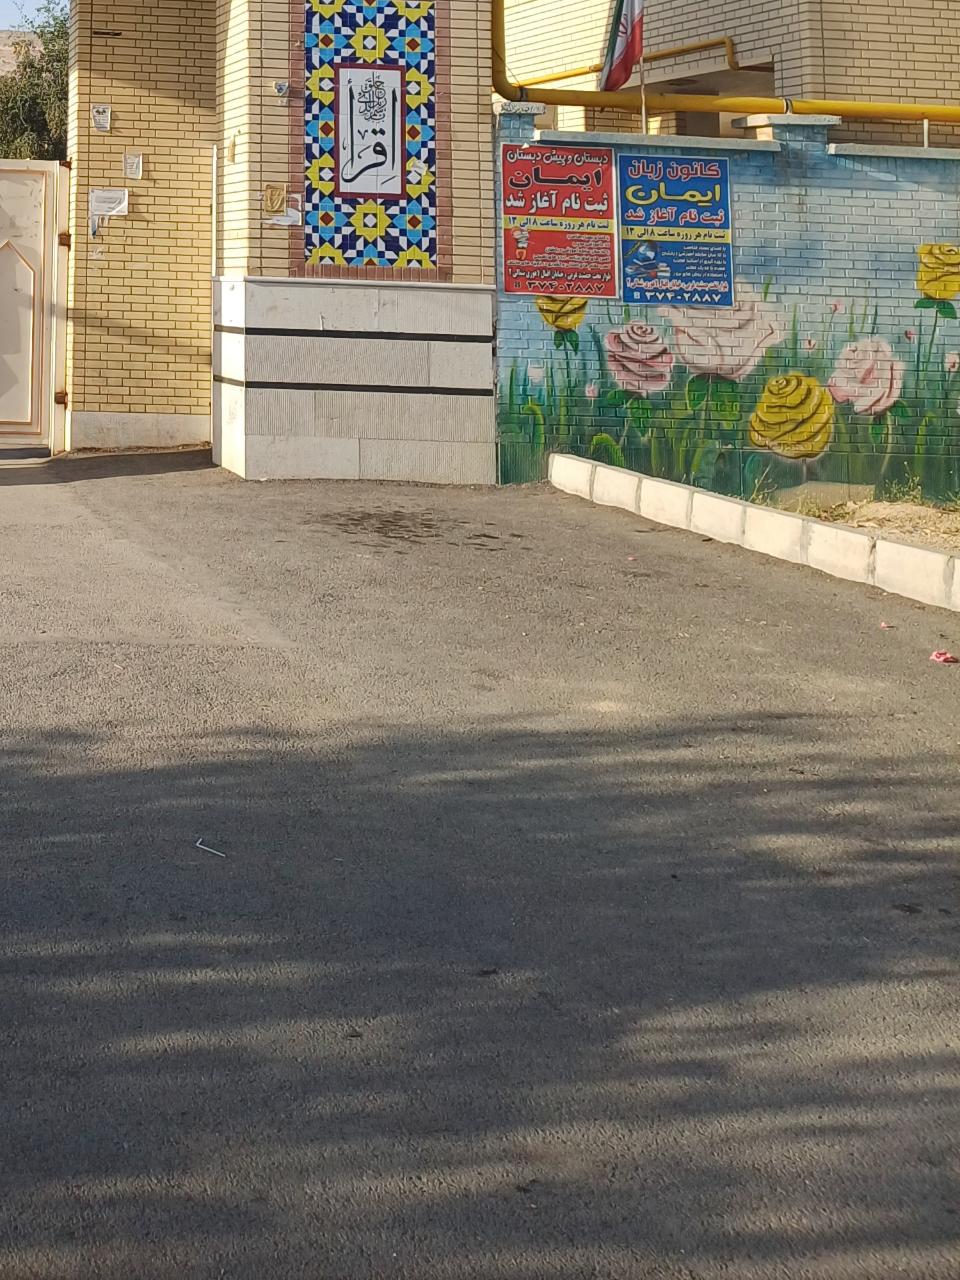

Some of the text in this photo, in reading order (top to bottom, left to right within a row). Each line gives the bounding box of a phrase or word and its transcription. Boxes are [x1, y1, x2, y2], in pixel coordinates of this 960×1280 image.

[506, 148, 609, 167] دبستان و پیش دبستان
[508, 166, 602, 192] ایمان
[628, 159, 721, 181] کانون زبان
[505, 190, 609, 216] ثبت نام آغاز شد
[625, 181, 721, 206] ایمان
[625, 206, 725, 226] ثبت نام آغاز شد
